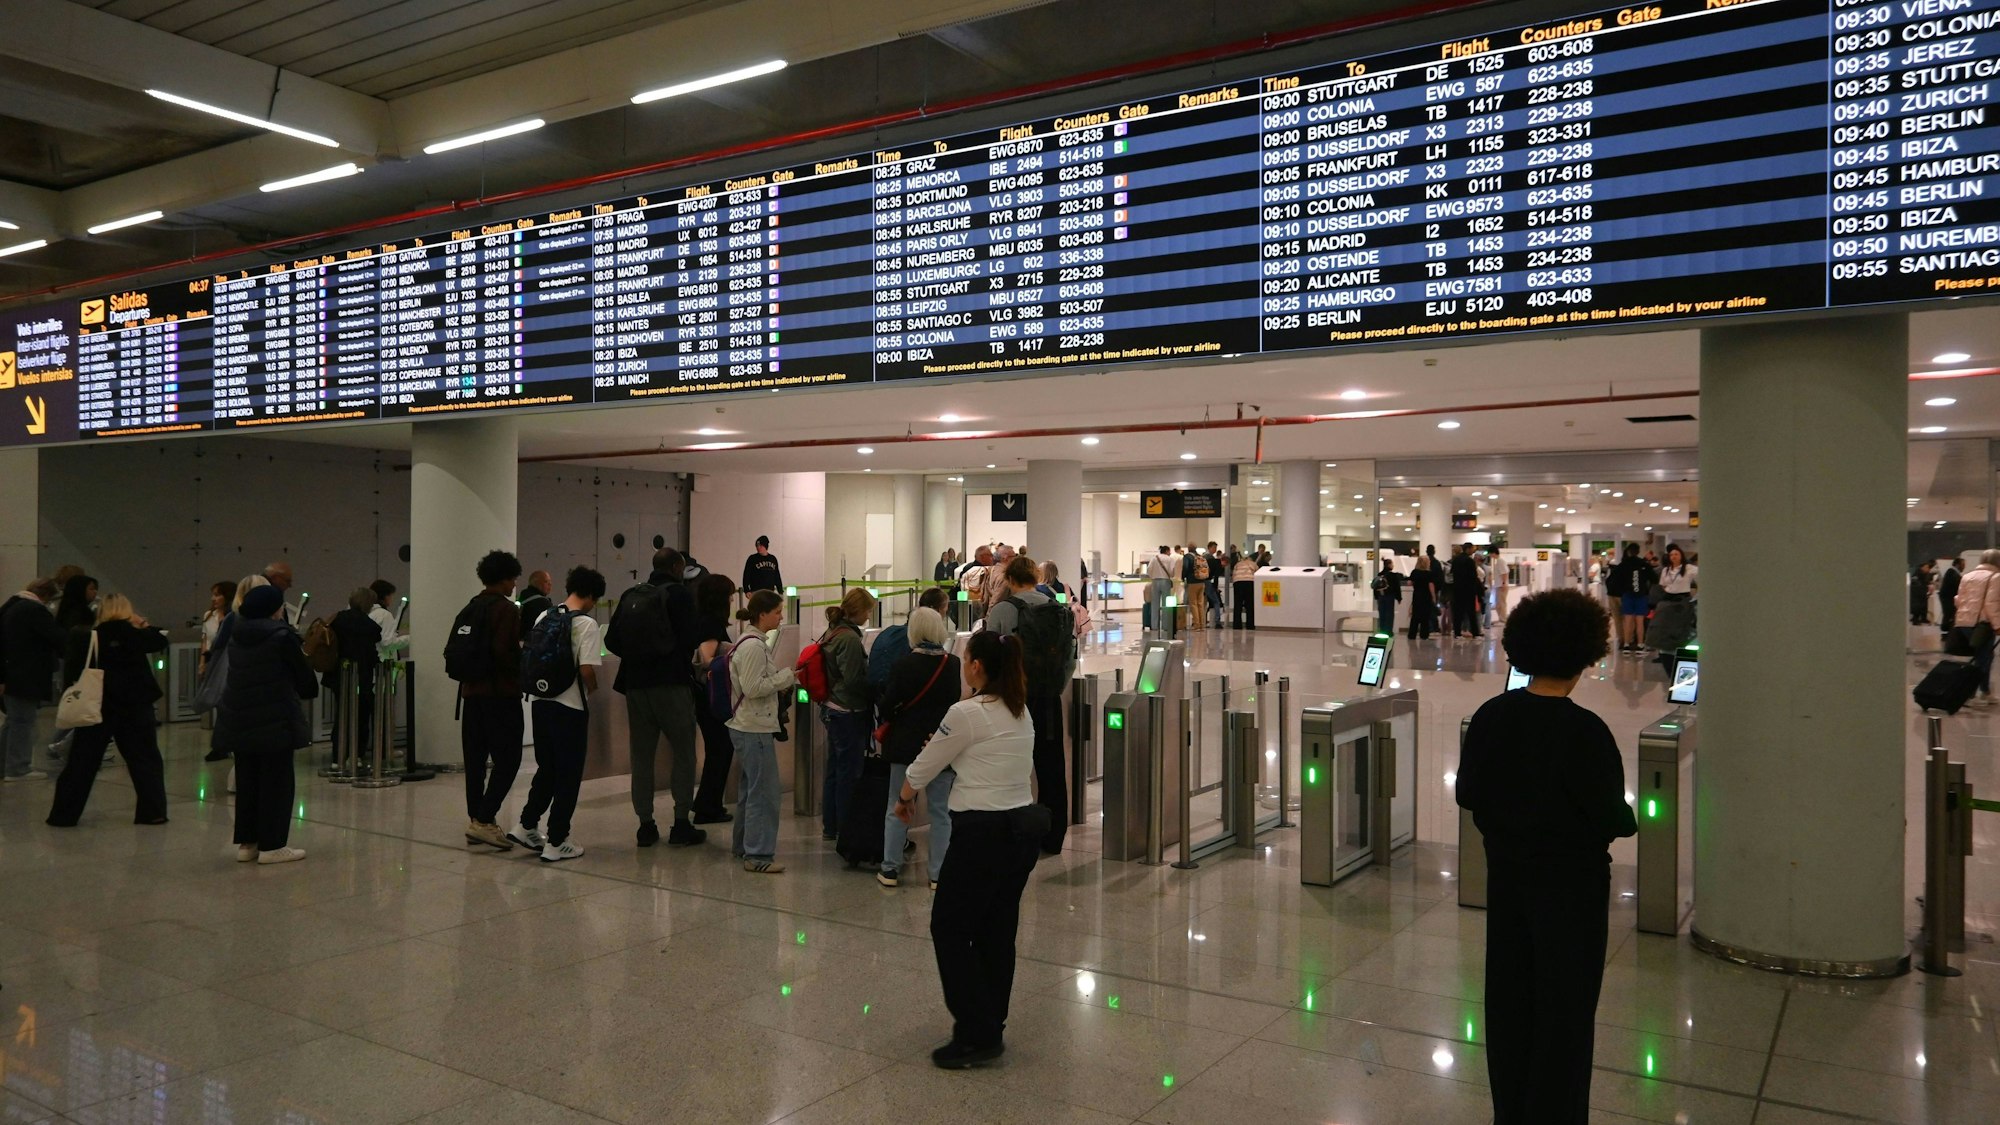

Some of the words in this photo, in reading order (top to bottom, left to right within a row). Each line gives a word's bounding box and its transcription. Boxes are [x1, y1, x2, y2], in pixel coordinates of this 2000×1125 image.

[1835, 6, 1890, 30] 09:30
[1264, 77, 1299, 92] Time
[1346, 62, 1365, 76] To
[1442, 38, 1489, 59] Flight
[1521, 18, 1603, 45] Counters
[1617, 6, 1661, 27] Gate
[1835, 30, 1890, 52] 09:30
[1835, 52, 1890, 75] 09:35
[1902, 38, 1975, 65] JEREZ
[1264, 93, 1300, 110] 09:00
[1308, 74, 1397, 102] STUTTGART
[1427, 65, 1448, 81] DE
[1468, 55, 1504, 73] 1525
[1528, 39, 1593, 62] 603-608
[1835, 75, 1889, 98] 09:35
[1264, 111, 1300, 129] 09:00
[1307, 98, 1375, 121] COLONIA
[1426, 82, 1465, 101] EWG
[1476, 74, 1504, 92] 587
[1528, 58, 1593, 83] 623-635
[1835, 99, 1889, 121] 09:40
[1901, 84, 1987, 112] ZURICH
[876, 151, 901, 162] Time
[935, 141, 947, 152] To
[1000, 126, 1033, 140] Flight
[1054, 112, 1109, 131] Counters
[1119, 105, 1149, 119] Gate
[1179, 88, 1238, 108] Remarks
[1264, 130, 1300, 147] 09:00
[1308, 115, 1387, 140] BRUSELAS
[1426, 105, 1447, 120] TB
[1468, 95, 1504, 113] 1417
[1528, 80, 1593, 104] 228-238
[1834, 122, 1889, 143] 09:40
[1902, 109, 1983, 134] BERLIN
[1264, 148, 1300, 166] 09:05
[1308, 130, 1410, 159] DUSSELDORF
[1426, 124, 1446, 140] X3
[1466, 115, 1504, 134] 2313
[1528, 101, 1593, 124] 229-238
[1834, 145, 1889, 166] 09:45
[1902, 136, 1958, 158] IBIZA
[876, 180, 901, 195] 08:25
[907, 170, 960, 189] MENORCA
[990, 161, 1007, 176] IBE
[1017, 155, 1043, 171] 2494
[1059, 145, 1103, 164] 514-518
[1264, 166, 1300, 184] 09:05
[1308, 151, 1398, 177] FRANKFURT
[1426, 144, 1446, 160] LH
[1469, 135, 1504, 153] 1155
[1528, 122, 1590, 144] 323-331
[1834, 168, 1888, 189] 09:45
[1901, 154, 1999, 181] HAMBUR
[686, 186, 710, 198] Flight
[725, 177, 766, 192] Counters
[773, 171, 794, 183] Gate
[816, 160, 858, 174] Remarks
[1264, 185, 1300, 202] 09:05
[1308, 169, 1410, 196] DUSSELDORF
[1426, 164, 1446, 180] X3
[1466, 156, 1504, 174] 2323
[1528, 143, 1592, 165] 229-238
[876, 211, 901, 225] 08:35
[907, 200, 971, 221] BARCELONA
[989, 194, 1012, 208] VLG
[1017, 189, 1043, 204] 3903
[1059, 179, 1103, 197] 503-508
[1264, 204, 1300, 220] 09:10
[1307, 194, 1374, 214] COLONIA
[1426, 183, 1448, 199] KK
[1469, 176, 1501, 193] 0111
[1528, 163, 1592, 185] 617-618
[1834, 191, 1888, 211] 09:45
[1901, 180, 1982, 204] BERLIN
[549, 211, 582, 223] Remarks
[617, 224, 648, 237] MADRID
[678, 215, 695, 228] RYR
[703, 212, 717, 223] 403
[729, 204, 761, 219] 203-218
[876, 227, 901, 241] 08:45
[907, 216, 970, 236] KARLSRUHE
[990, 210, 1013, 224] RYR
[1017, 206, 1043, 220] 8207
[1059, 197, 1103, 214] 203-218
[1264, 222, 1300, 239] 09:10
[1308, 208, 1410, 234] DUSSELDORF
[1528, 184, 1592, 206] 623-635
[1833, 214, 1888, 234] 09:50
[1901, 207, 1957, 227] IBIZA
[1264, 241, 1300, 257] 09:15
[1308, 233, 1366, 252] MADRID
[1426, 224, 1439, 238] I2
[1467, 216, 1503, 233] 1652
[1528, 205, 1592, 226] 514-518
[1833, 237, 1888, 257] 09:50
[1264, 259, 1300, 275] 09:20
[1307, 250, 1379, 270] OSTENDE
[1425, 243, 1446, 257] TB
[1467, 236, 1503, 253] 1453
[1527, 226, 1592, 246] 234-238
[1264, 278, 1300, 294] 09:20
[1307, 269, 1380, 289] ALICANTE
[1426, 262, 1446, 277] TB
[1467, 256, 1503, 272] 1453
[1528, 247, 1592, 267] 234-238
[1833, 260, 1887, 279] 09:55
[1935, 279, 1985, 290] Please
[110, 291, 148, 311] Salidas
[1264, 296, 1300, 312] 09:25
[1308, 287, 1395, 308] HAMBURGO
[1527, 267, 1592, 287] 623-633
[110, 308, 150, 324] Departures
[1264, 315, 1300, 330] 09:25
[1308, 309, 1360, 326] BERLIN
[1426, 300, 1456, 316] EJU
[1466, 296, 1503, 312] 5120
[1527, 288, 1592, 306] 403-408
[17, 323, 31, 336] Vols
[50, 334, 70, 350] flights
[618, 331, 664, 345] EINDHOVEN
[679, 327, 696, 339] RYR
[699, 325, 717, 336] 3531
[730, 320, 762, 333] 203-218
[17, 371, 40, 385] Vuelos
